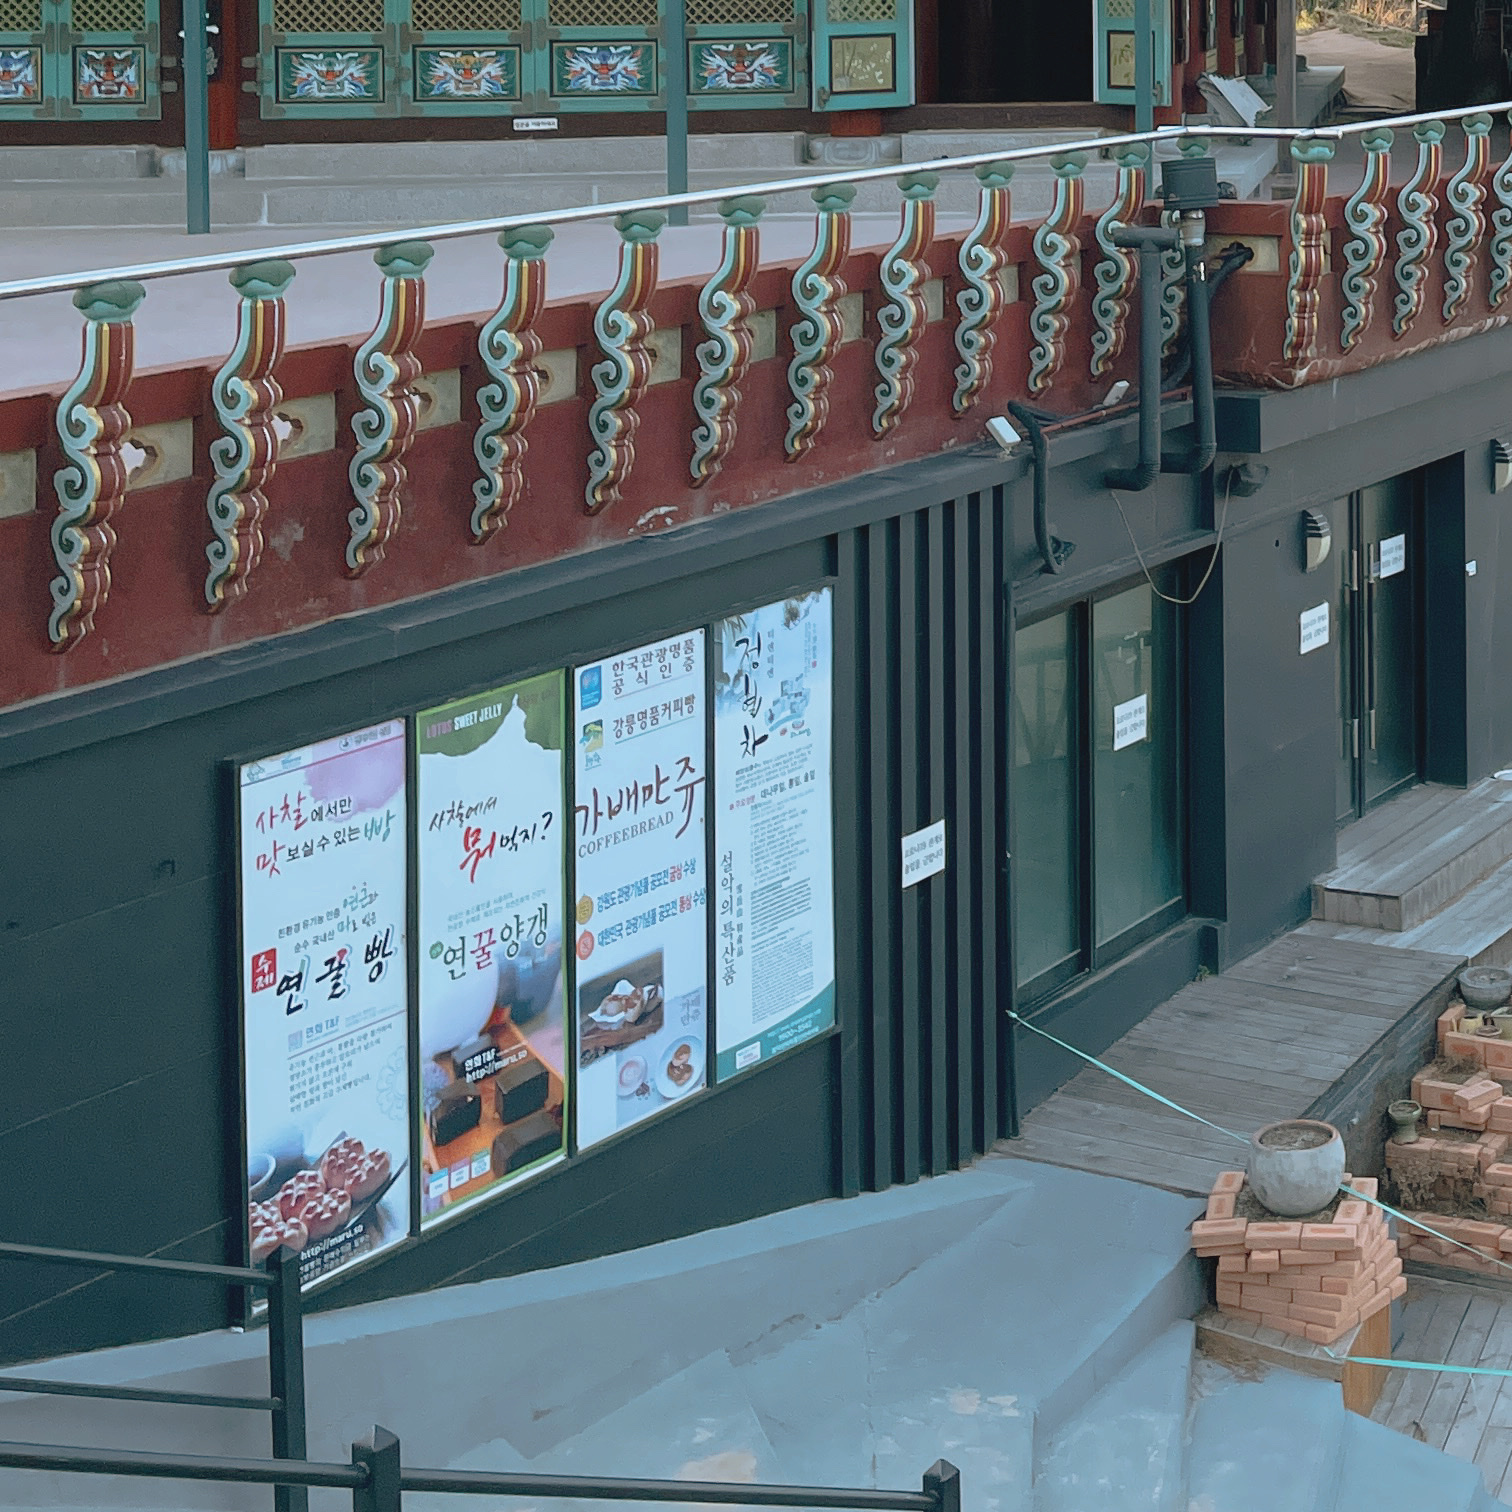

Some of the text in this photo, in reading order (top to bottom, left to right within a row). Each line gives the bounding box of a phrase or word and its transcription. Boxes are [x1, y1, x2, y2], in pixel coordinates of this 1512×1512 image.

[426, 702, 503, 739] LOTUS SWEET JELLY
[613, 693, 696, 739] 강릉명품커피빵
[317, 835, 330, 852] 수
[333, 825, 361, 846] 있는
[364, 809, 396, 842] 빵
[429, 796, 498, 831] 사찰에서
[578, 811, 674, 858] COFFEEBREAD
[459, 826, 497, 884] 뭐
[443, 902, 548, 981] 연꿀양갱
